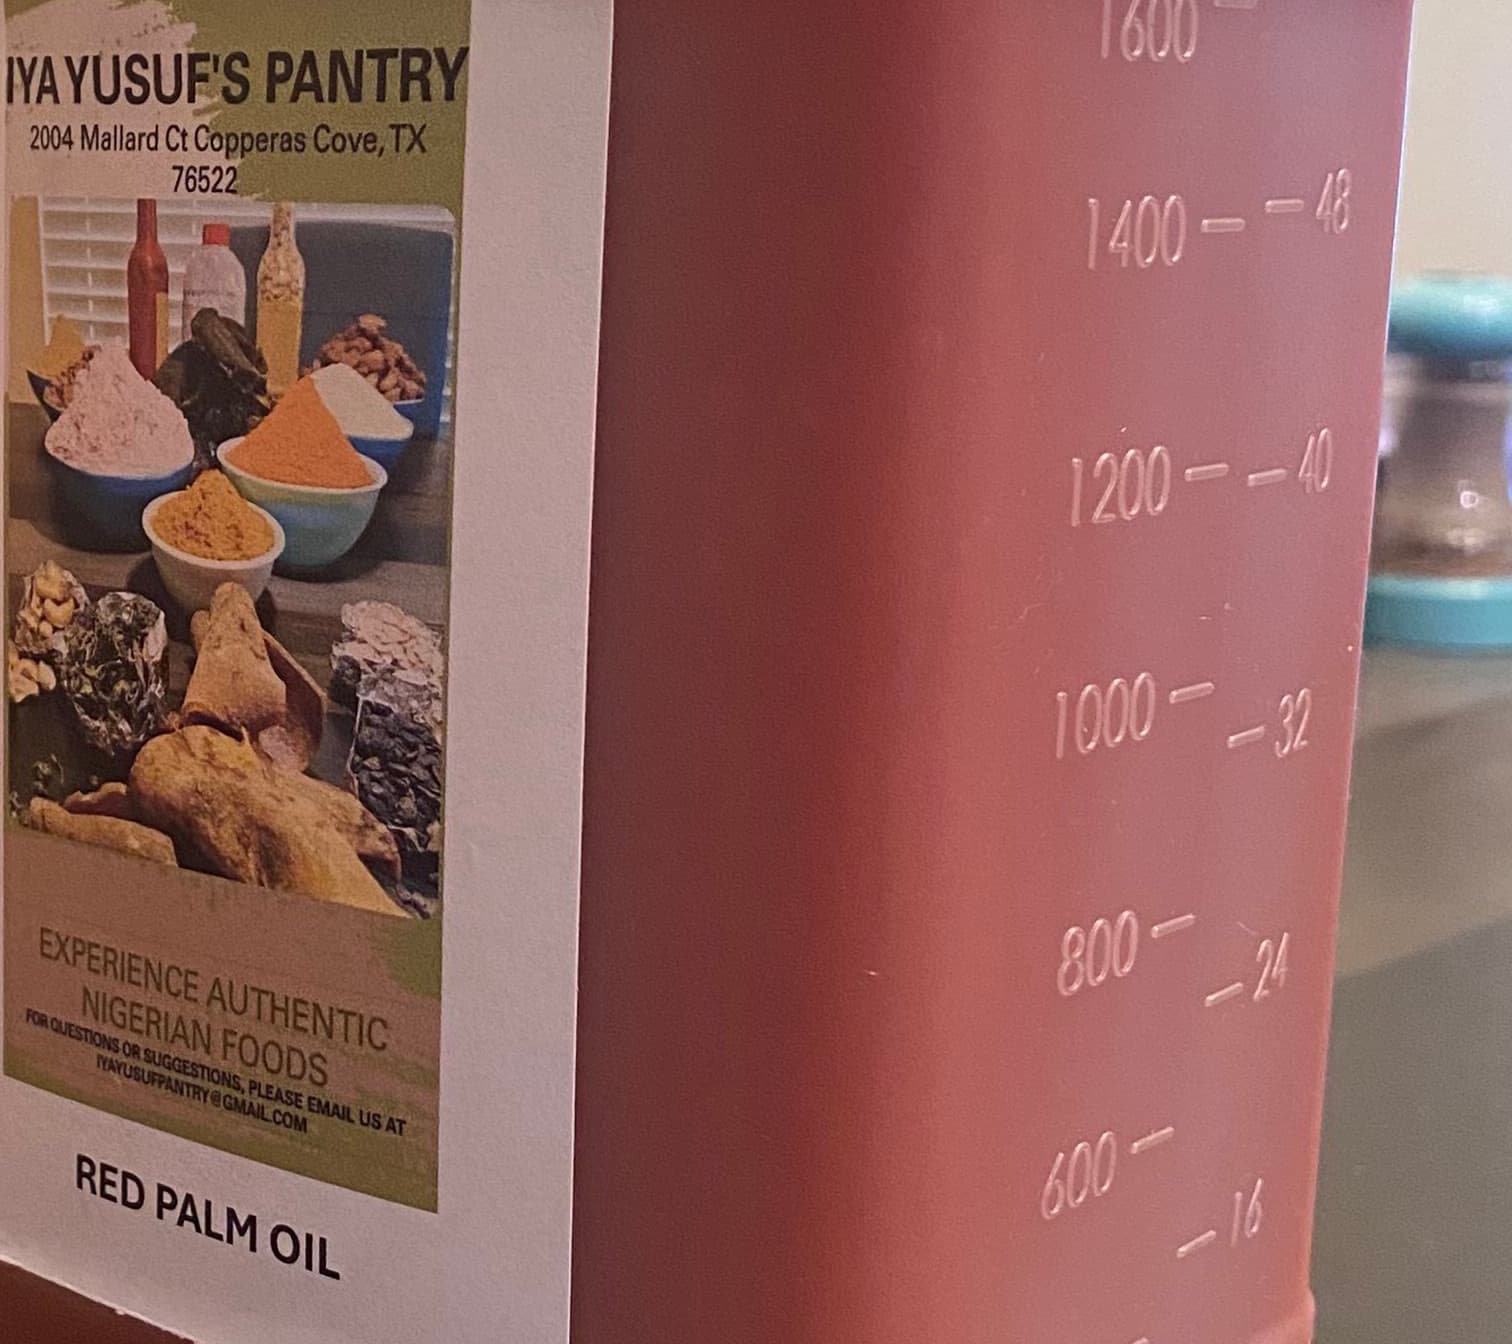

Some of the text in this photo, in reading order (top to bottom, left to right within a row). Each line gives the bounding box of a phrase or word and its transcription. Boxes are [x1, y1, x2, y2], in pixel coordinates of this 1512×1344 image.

[64, 51, 251, 105] YUSUF'S
[266, 46, 470, 103] PANTRY
[30, 123, 427, 159] 2004 Mallard Ct Copperas Cove, TX
[172, 165, 237, 193] 76522
[1315, 167, 1353, 234] 48
[1087, 195, 1188, 269] 1400
[1069, 445, 1172, 527] 1200
[1297, 427, 1333, 494] 40
[1055, 671, 1156, 759] 1000
[1274, 686, 1313, 759] 32
[39, 927, 388, 1051] EXPERIENCE AUTHENTIC
[1056, 909, 1139, 997] 800
[1253, 932, 1290, 1002] 24
[25, 1008, 407, 1136] FOR QUESTIONS OR SUGGESTIONS, PLEASE EMAIL US AT
[82, 986, 329, 1087] NIGERIAN FOODS
[1041, 1130, 1118, 1221] 600
[1230, 1176, 1264, 1248] 16
[76, 1153, 341, 1280] RED PALM OIL
